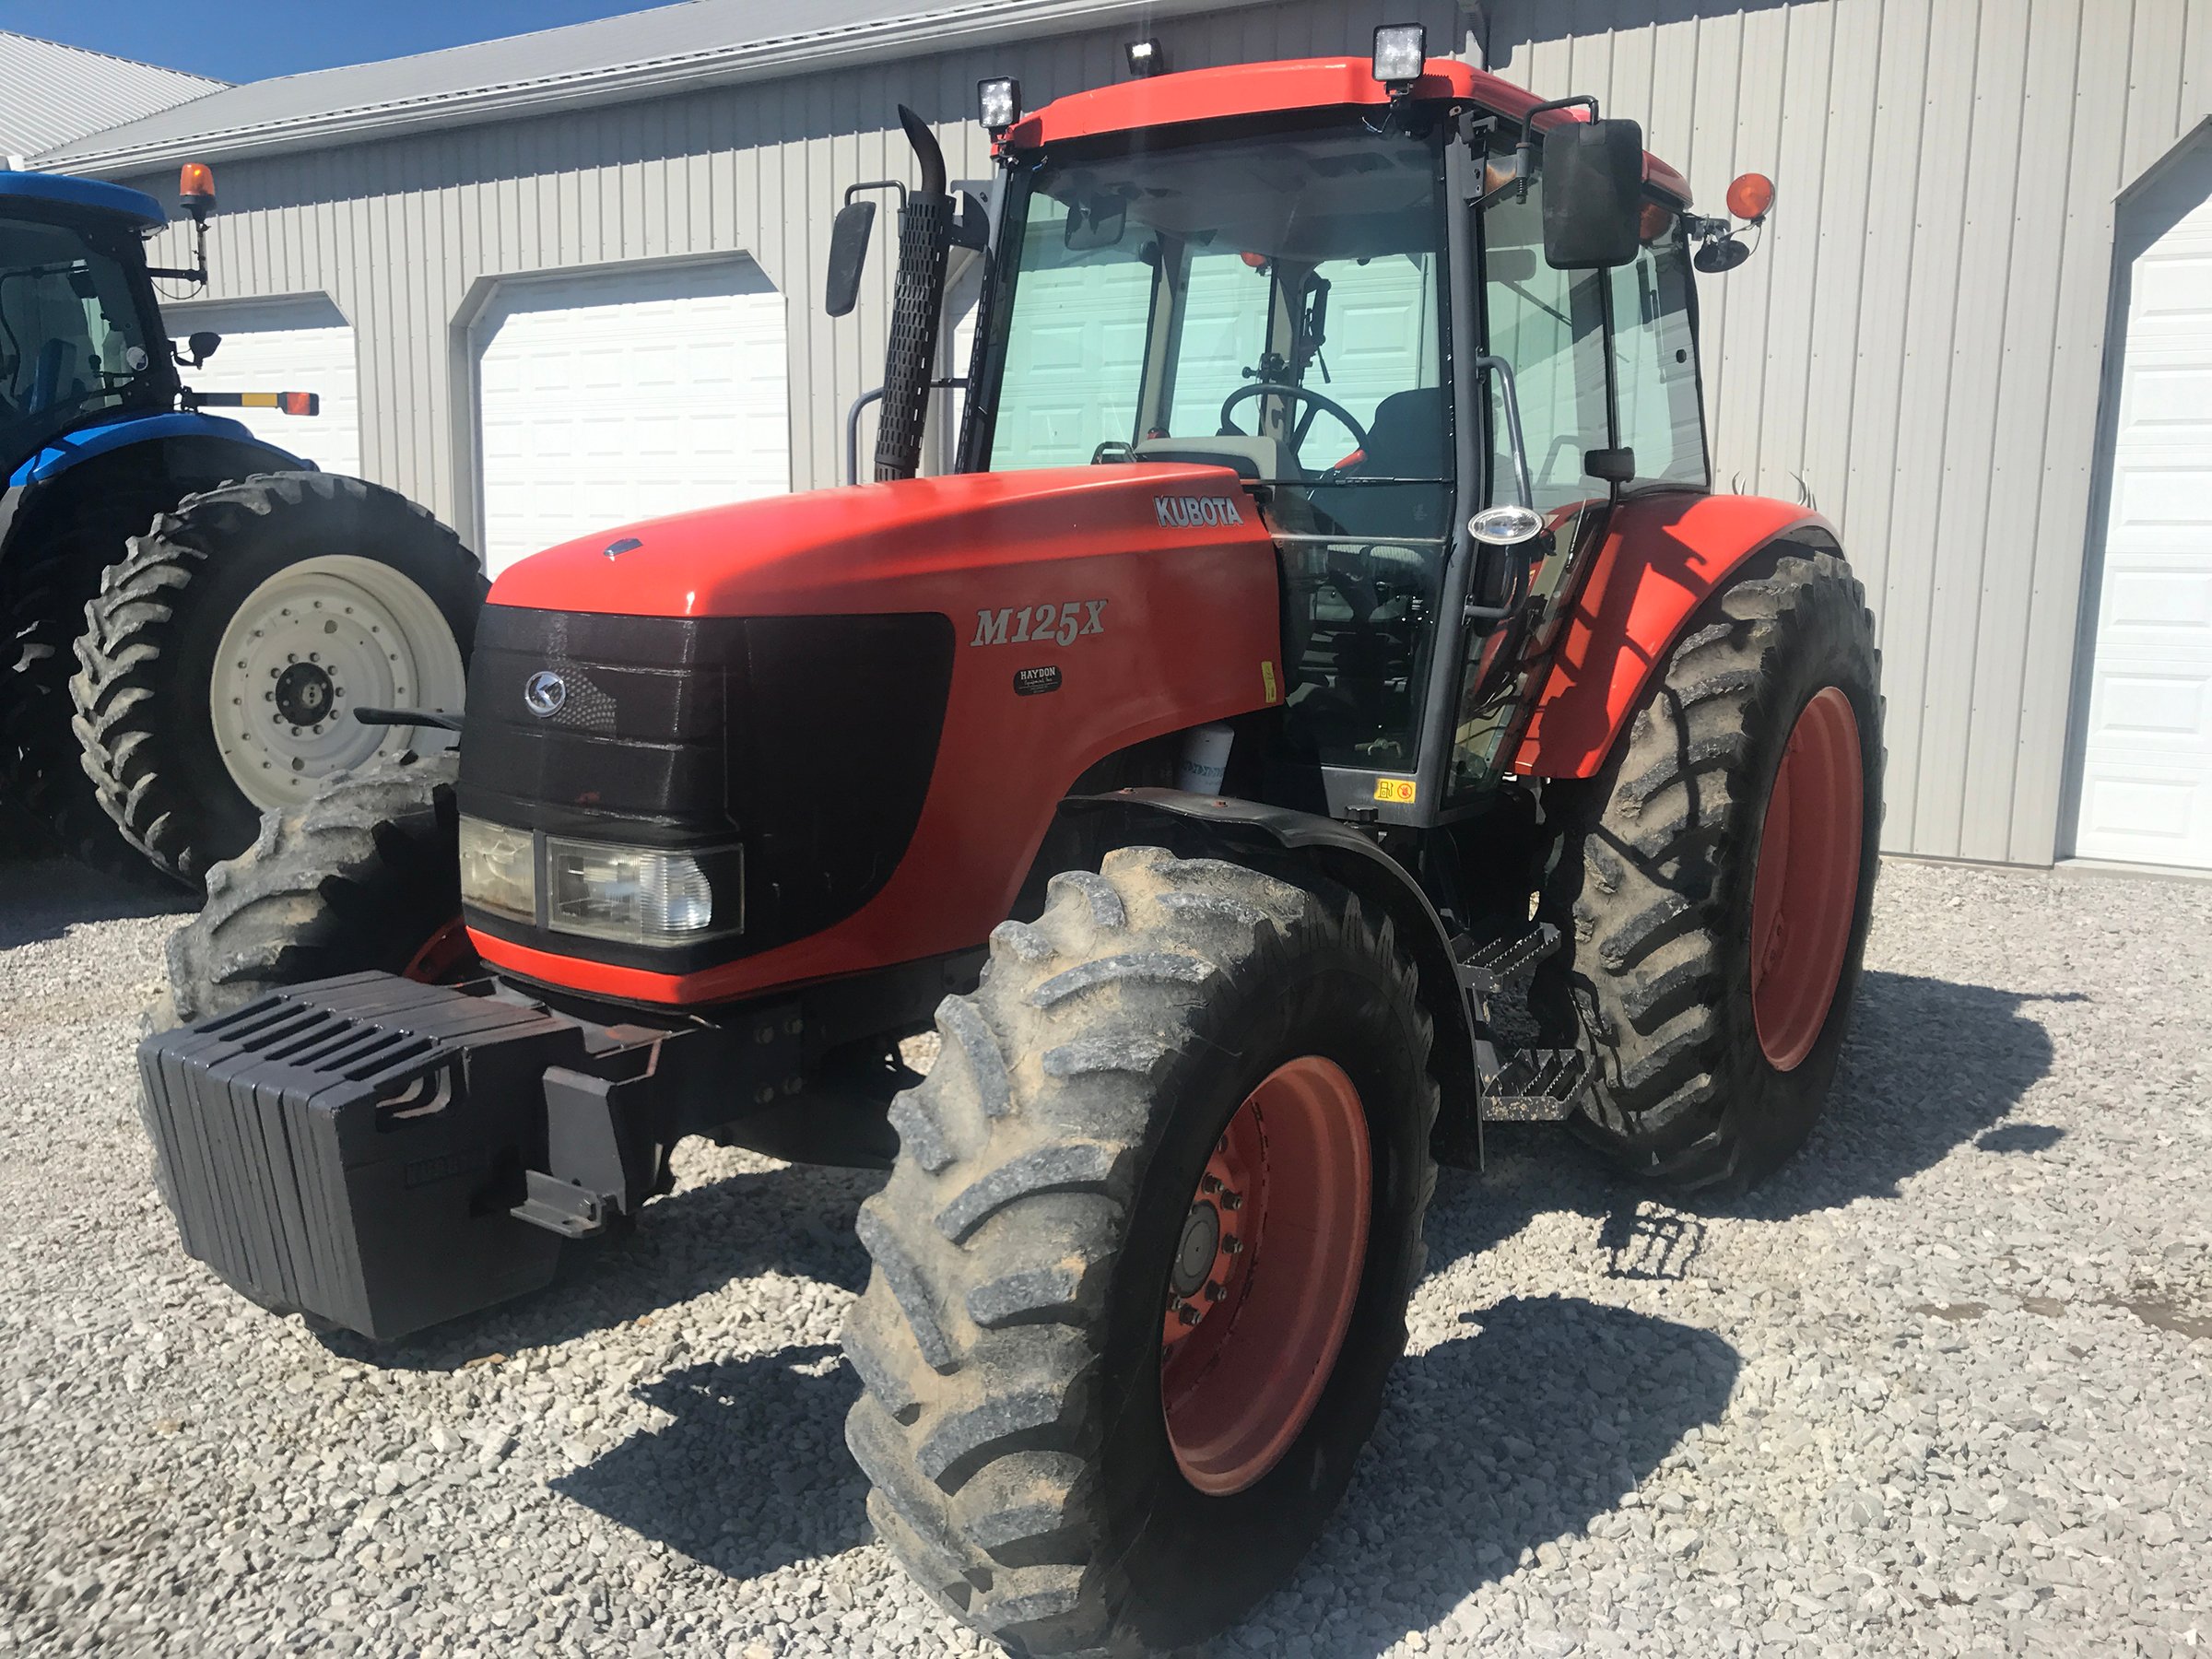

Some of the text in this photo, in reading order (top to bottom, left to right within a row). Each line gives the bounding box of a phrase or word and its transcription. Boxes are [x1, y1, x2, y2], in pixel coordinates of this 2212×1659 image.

[1154, 496, 1243, 527] KUBOTA
[970, 599, 1108, 646] M125X
[1020, 666, 1055, 679] HAYDON
